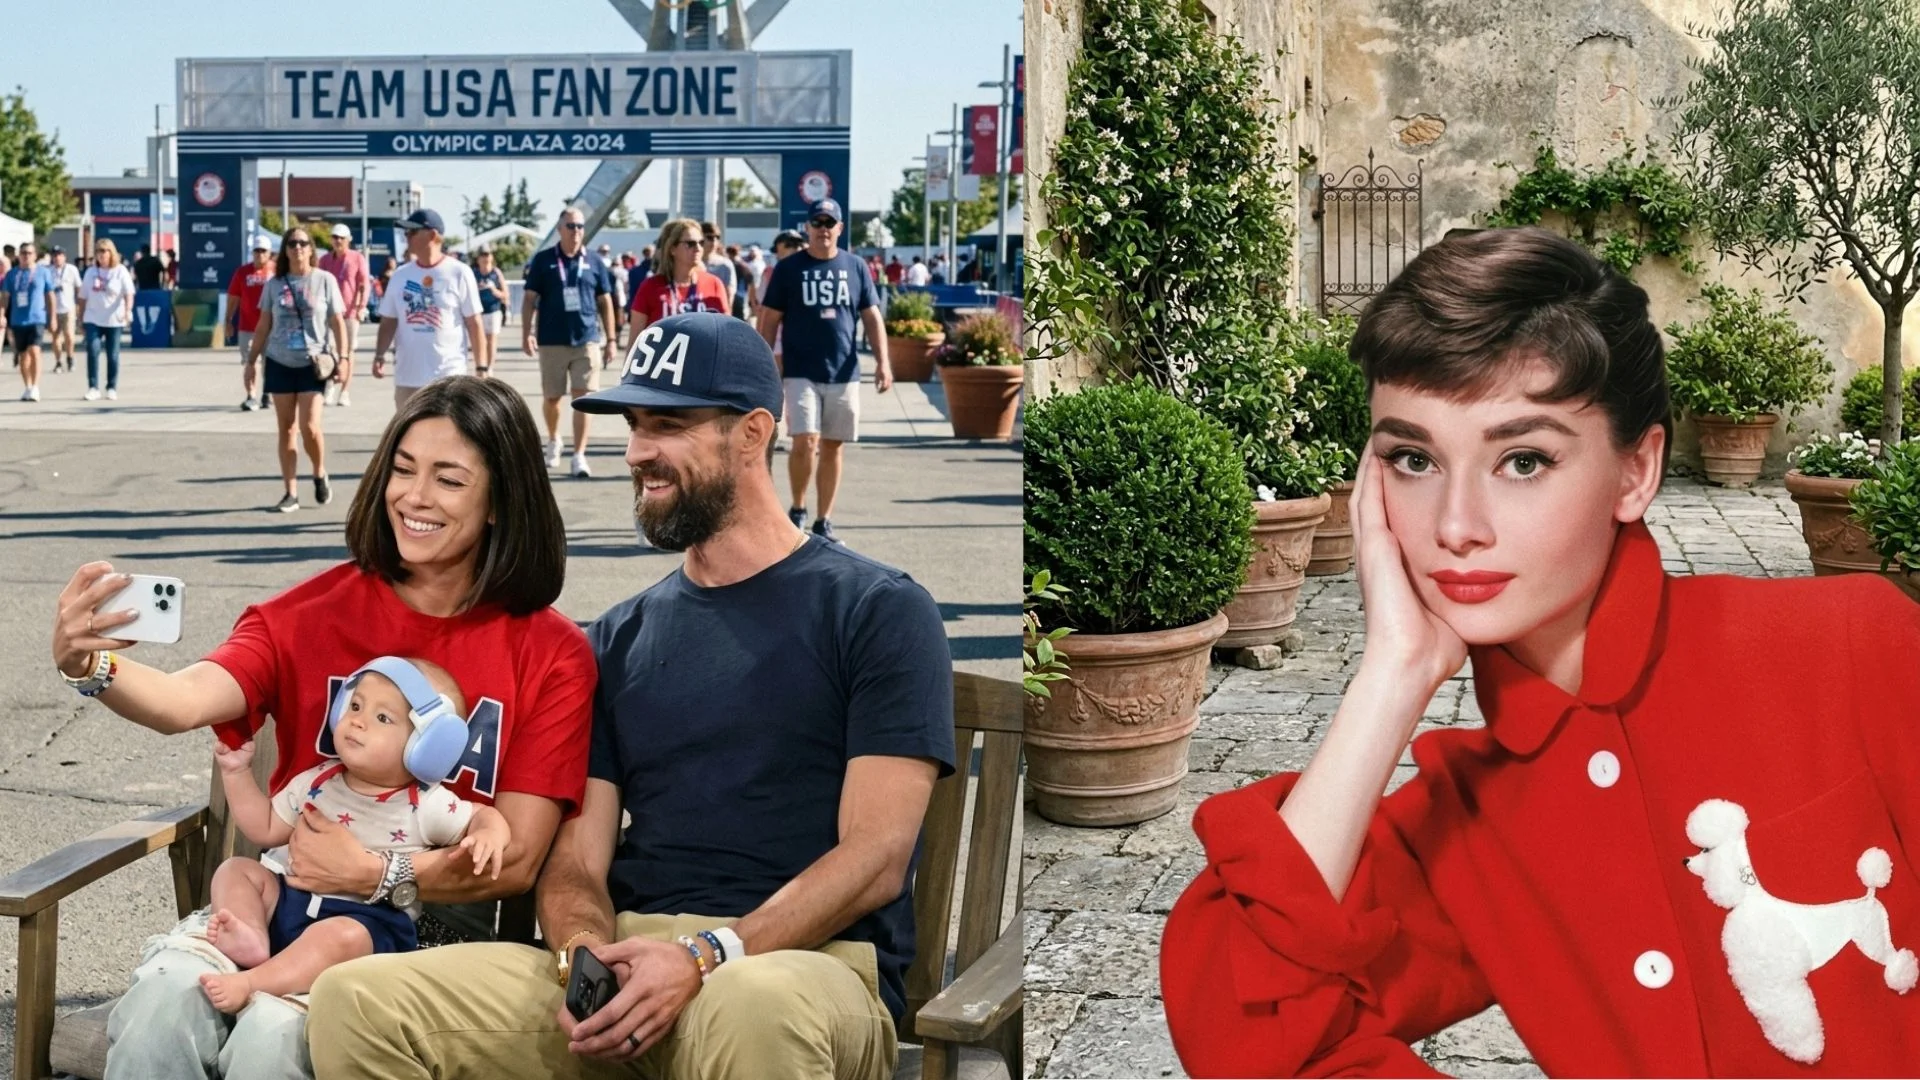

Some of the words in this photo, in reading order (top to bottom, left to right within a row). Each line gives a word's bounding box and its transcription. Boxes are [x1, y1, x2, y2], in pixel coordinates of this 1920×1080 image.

[284, 69, 405, 119] TEAM
[423, 68, 517, 118] USA
[532, 67, 612, 118] FAN
[625, 65, 737, 117] ZONE
[392, 134, 487, 153] OLYMPIC
[493, 134, 566, 152] PLAZA
[571, 133, 626, 151] 2024
[802, 270, 848, 280] TEAM
[802, 280, 850, 306] USA
